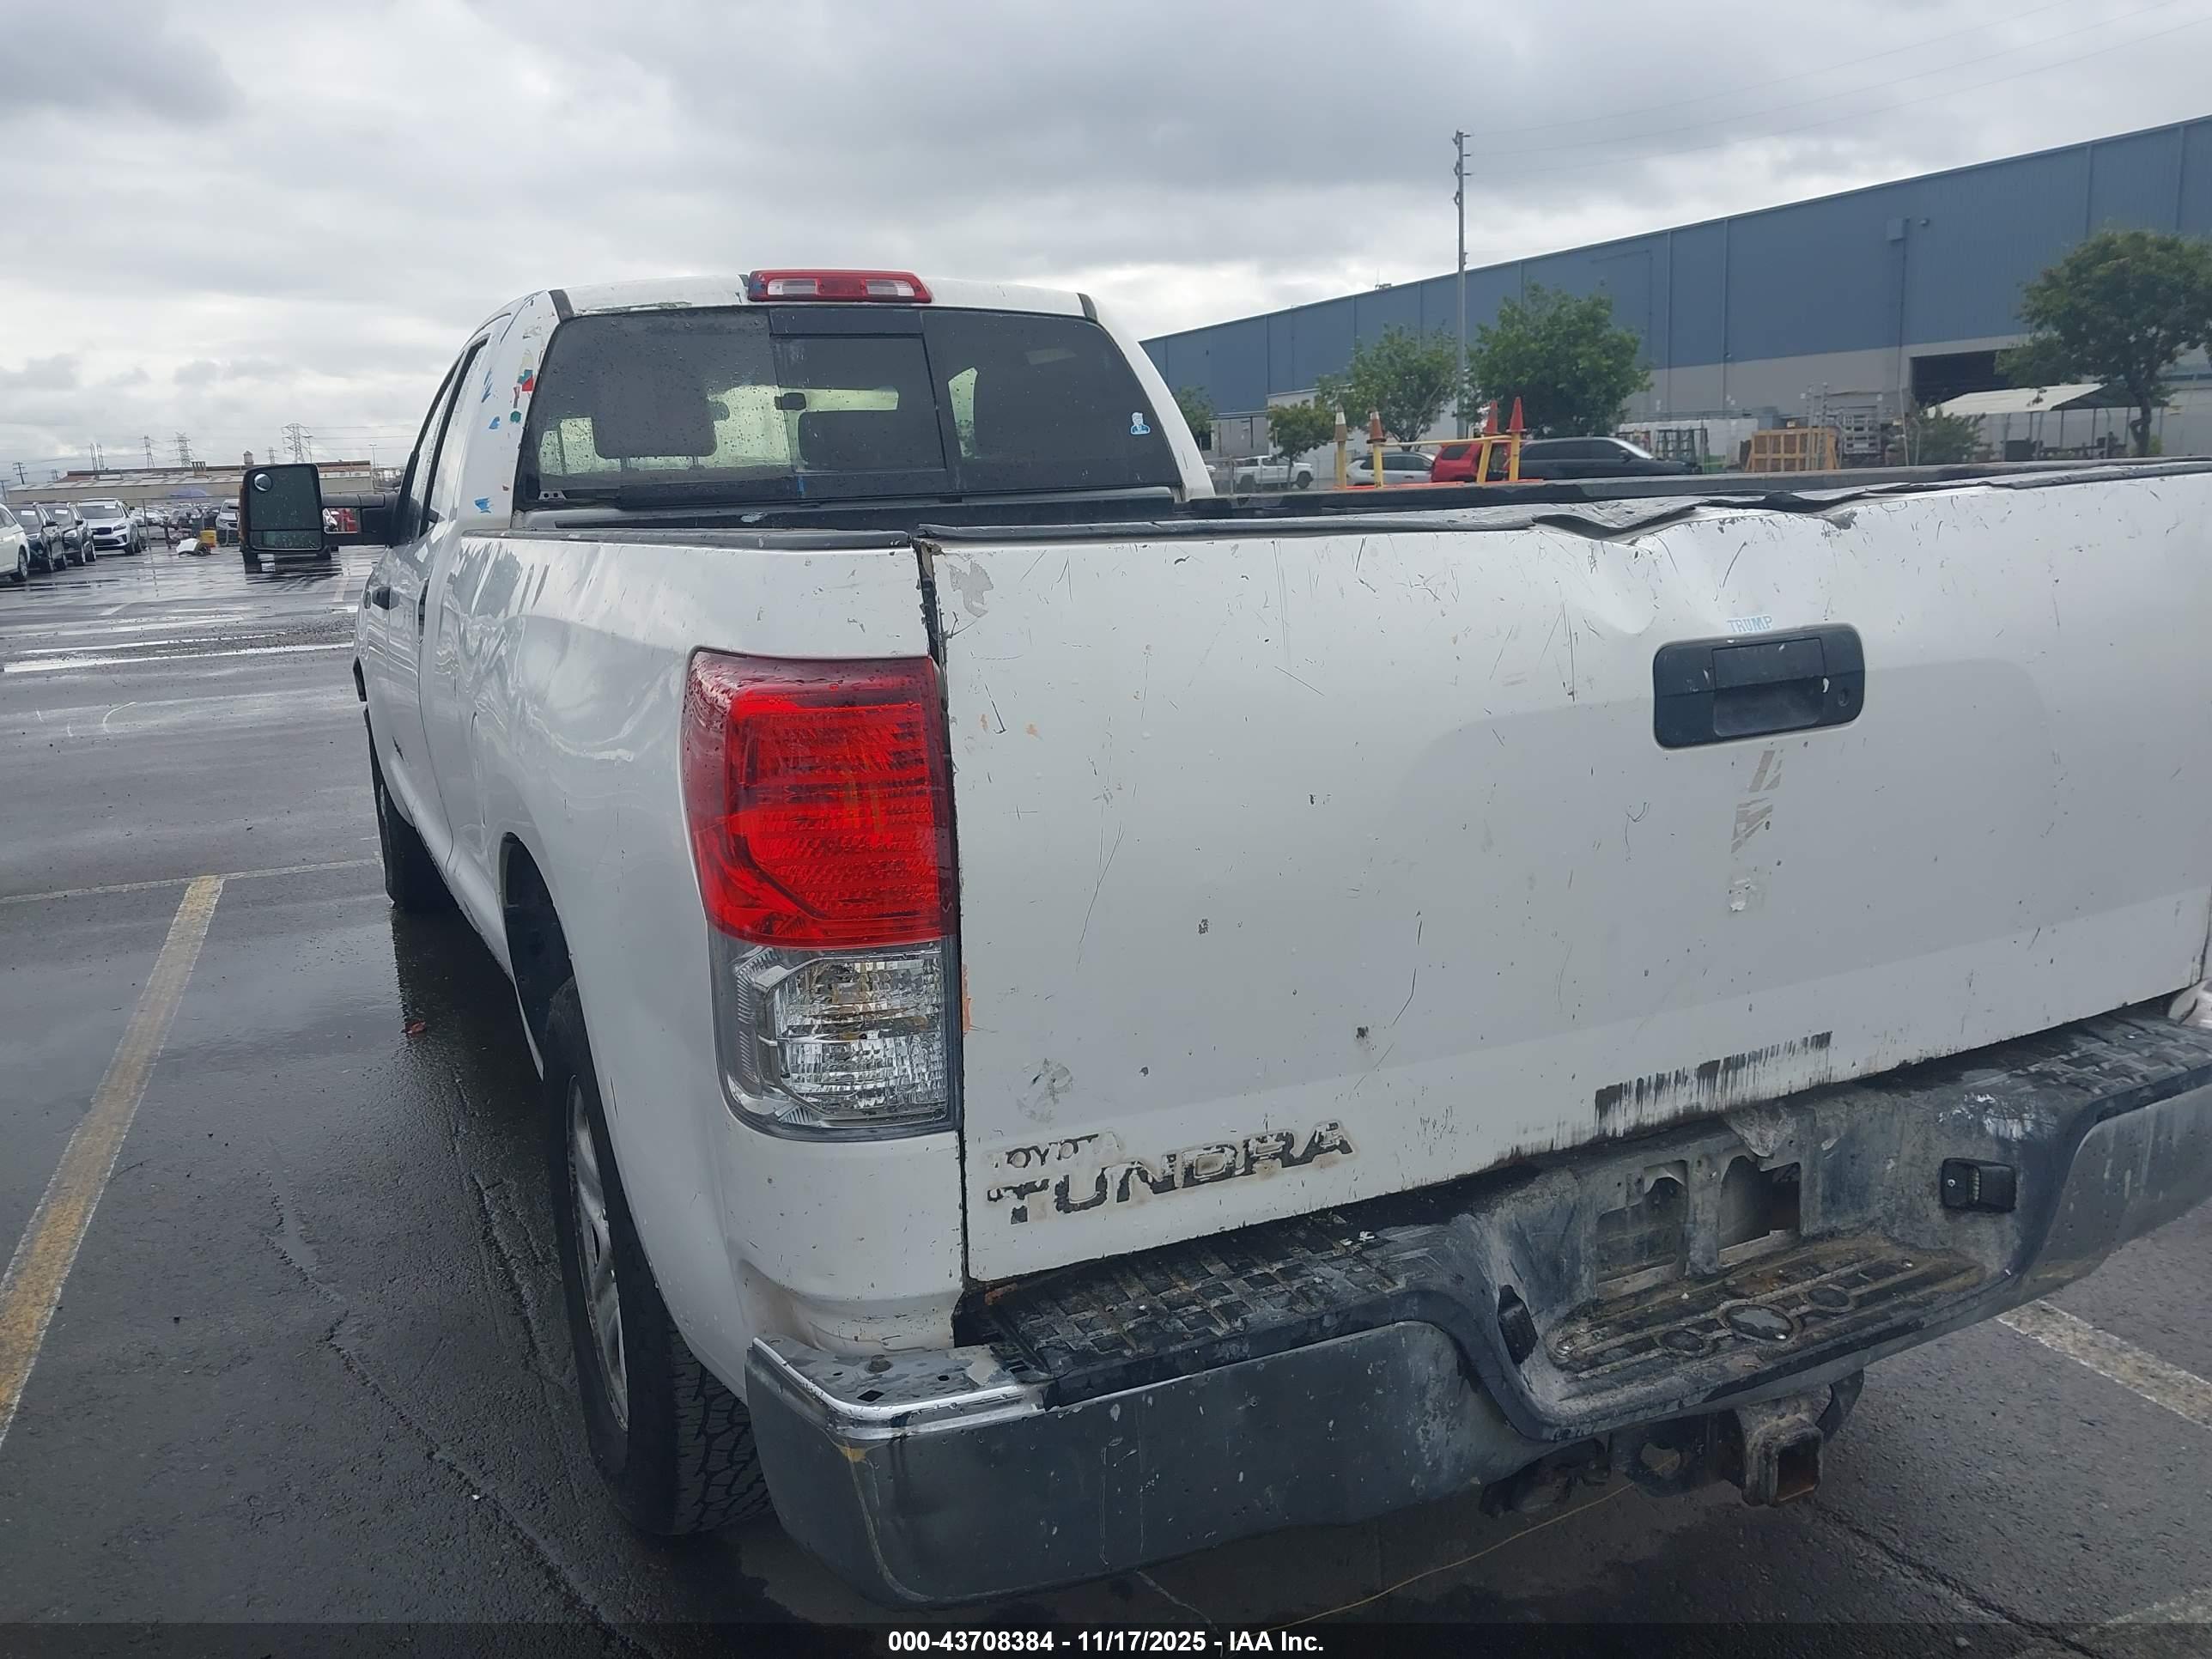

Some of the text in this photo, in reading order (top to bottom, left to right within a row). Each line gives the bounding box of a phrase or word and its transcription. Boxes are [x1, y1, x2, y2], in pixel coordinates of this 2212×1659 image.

[1726, 615, 1773, 633] TRUMP
[988, 1132, 1122, 1169] OYOT
[987, 1121, 1354, 1225] TUNDRA
